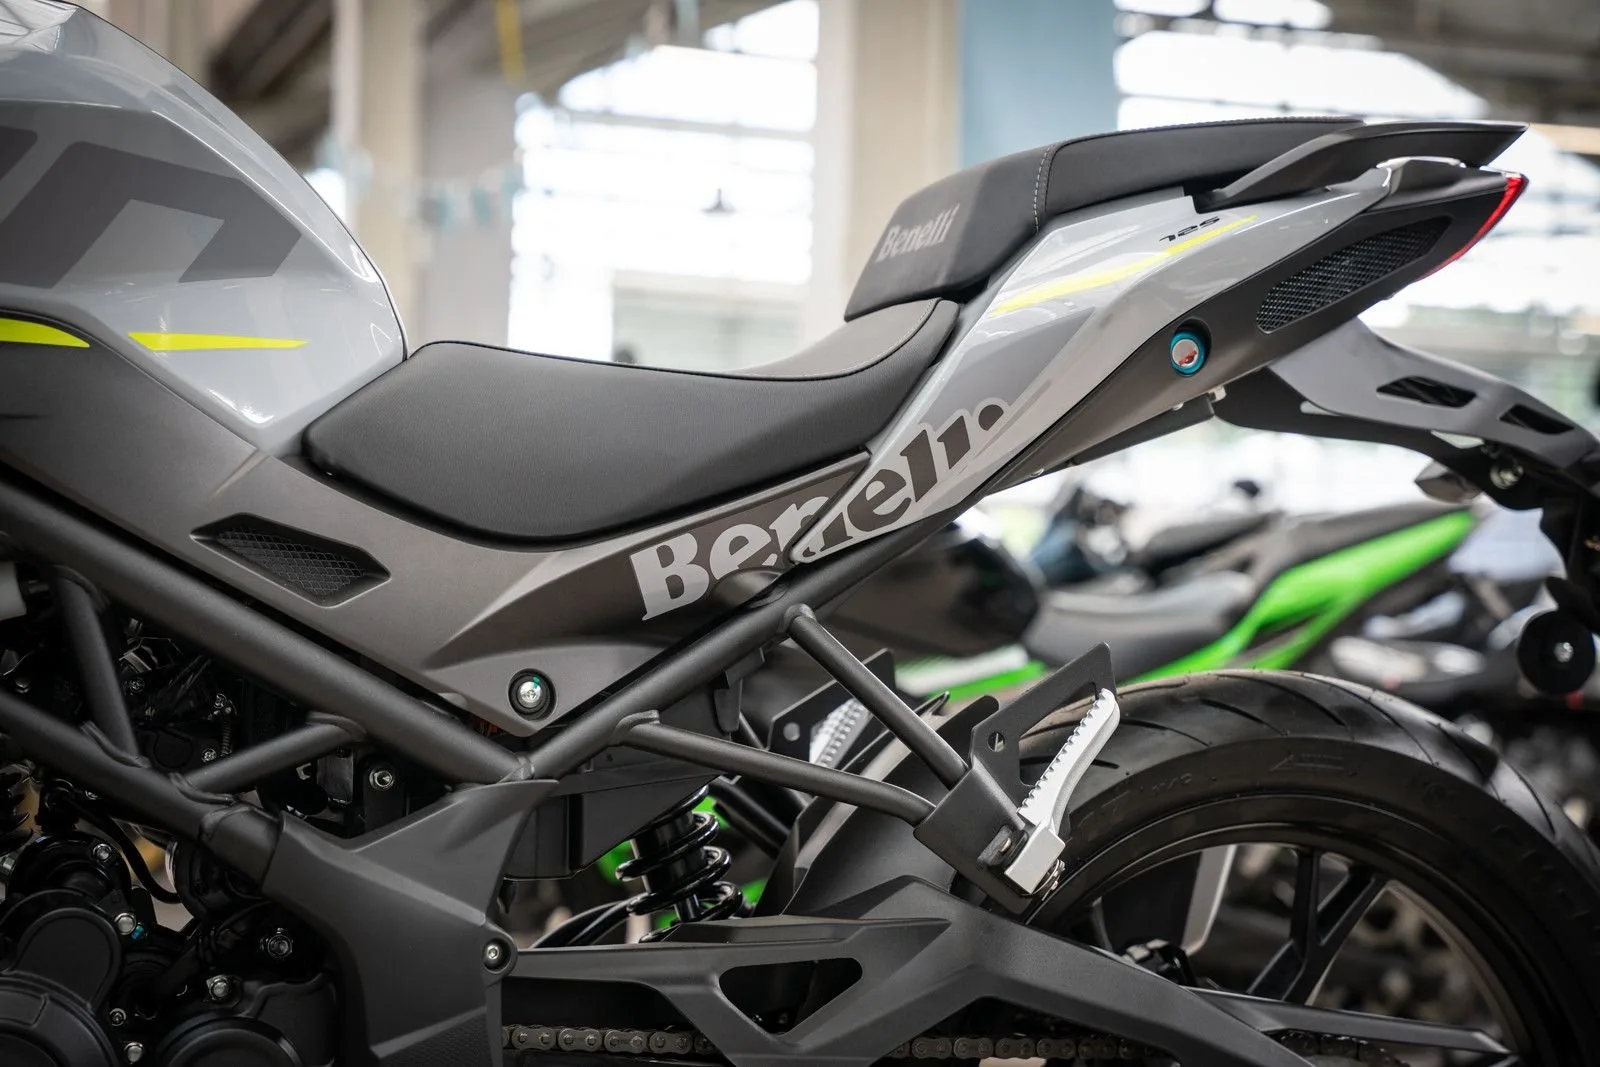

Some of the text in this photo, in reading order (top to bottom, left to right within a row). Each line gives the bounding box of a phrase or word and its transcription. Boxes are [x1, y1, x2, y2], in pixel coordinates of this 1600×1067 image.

[874, 202, 961, 264] Benelli
[1159, 215, 1220, 242] 125
[629, 403, 1005, 621] Benell
